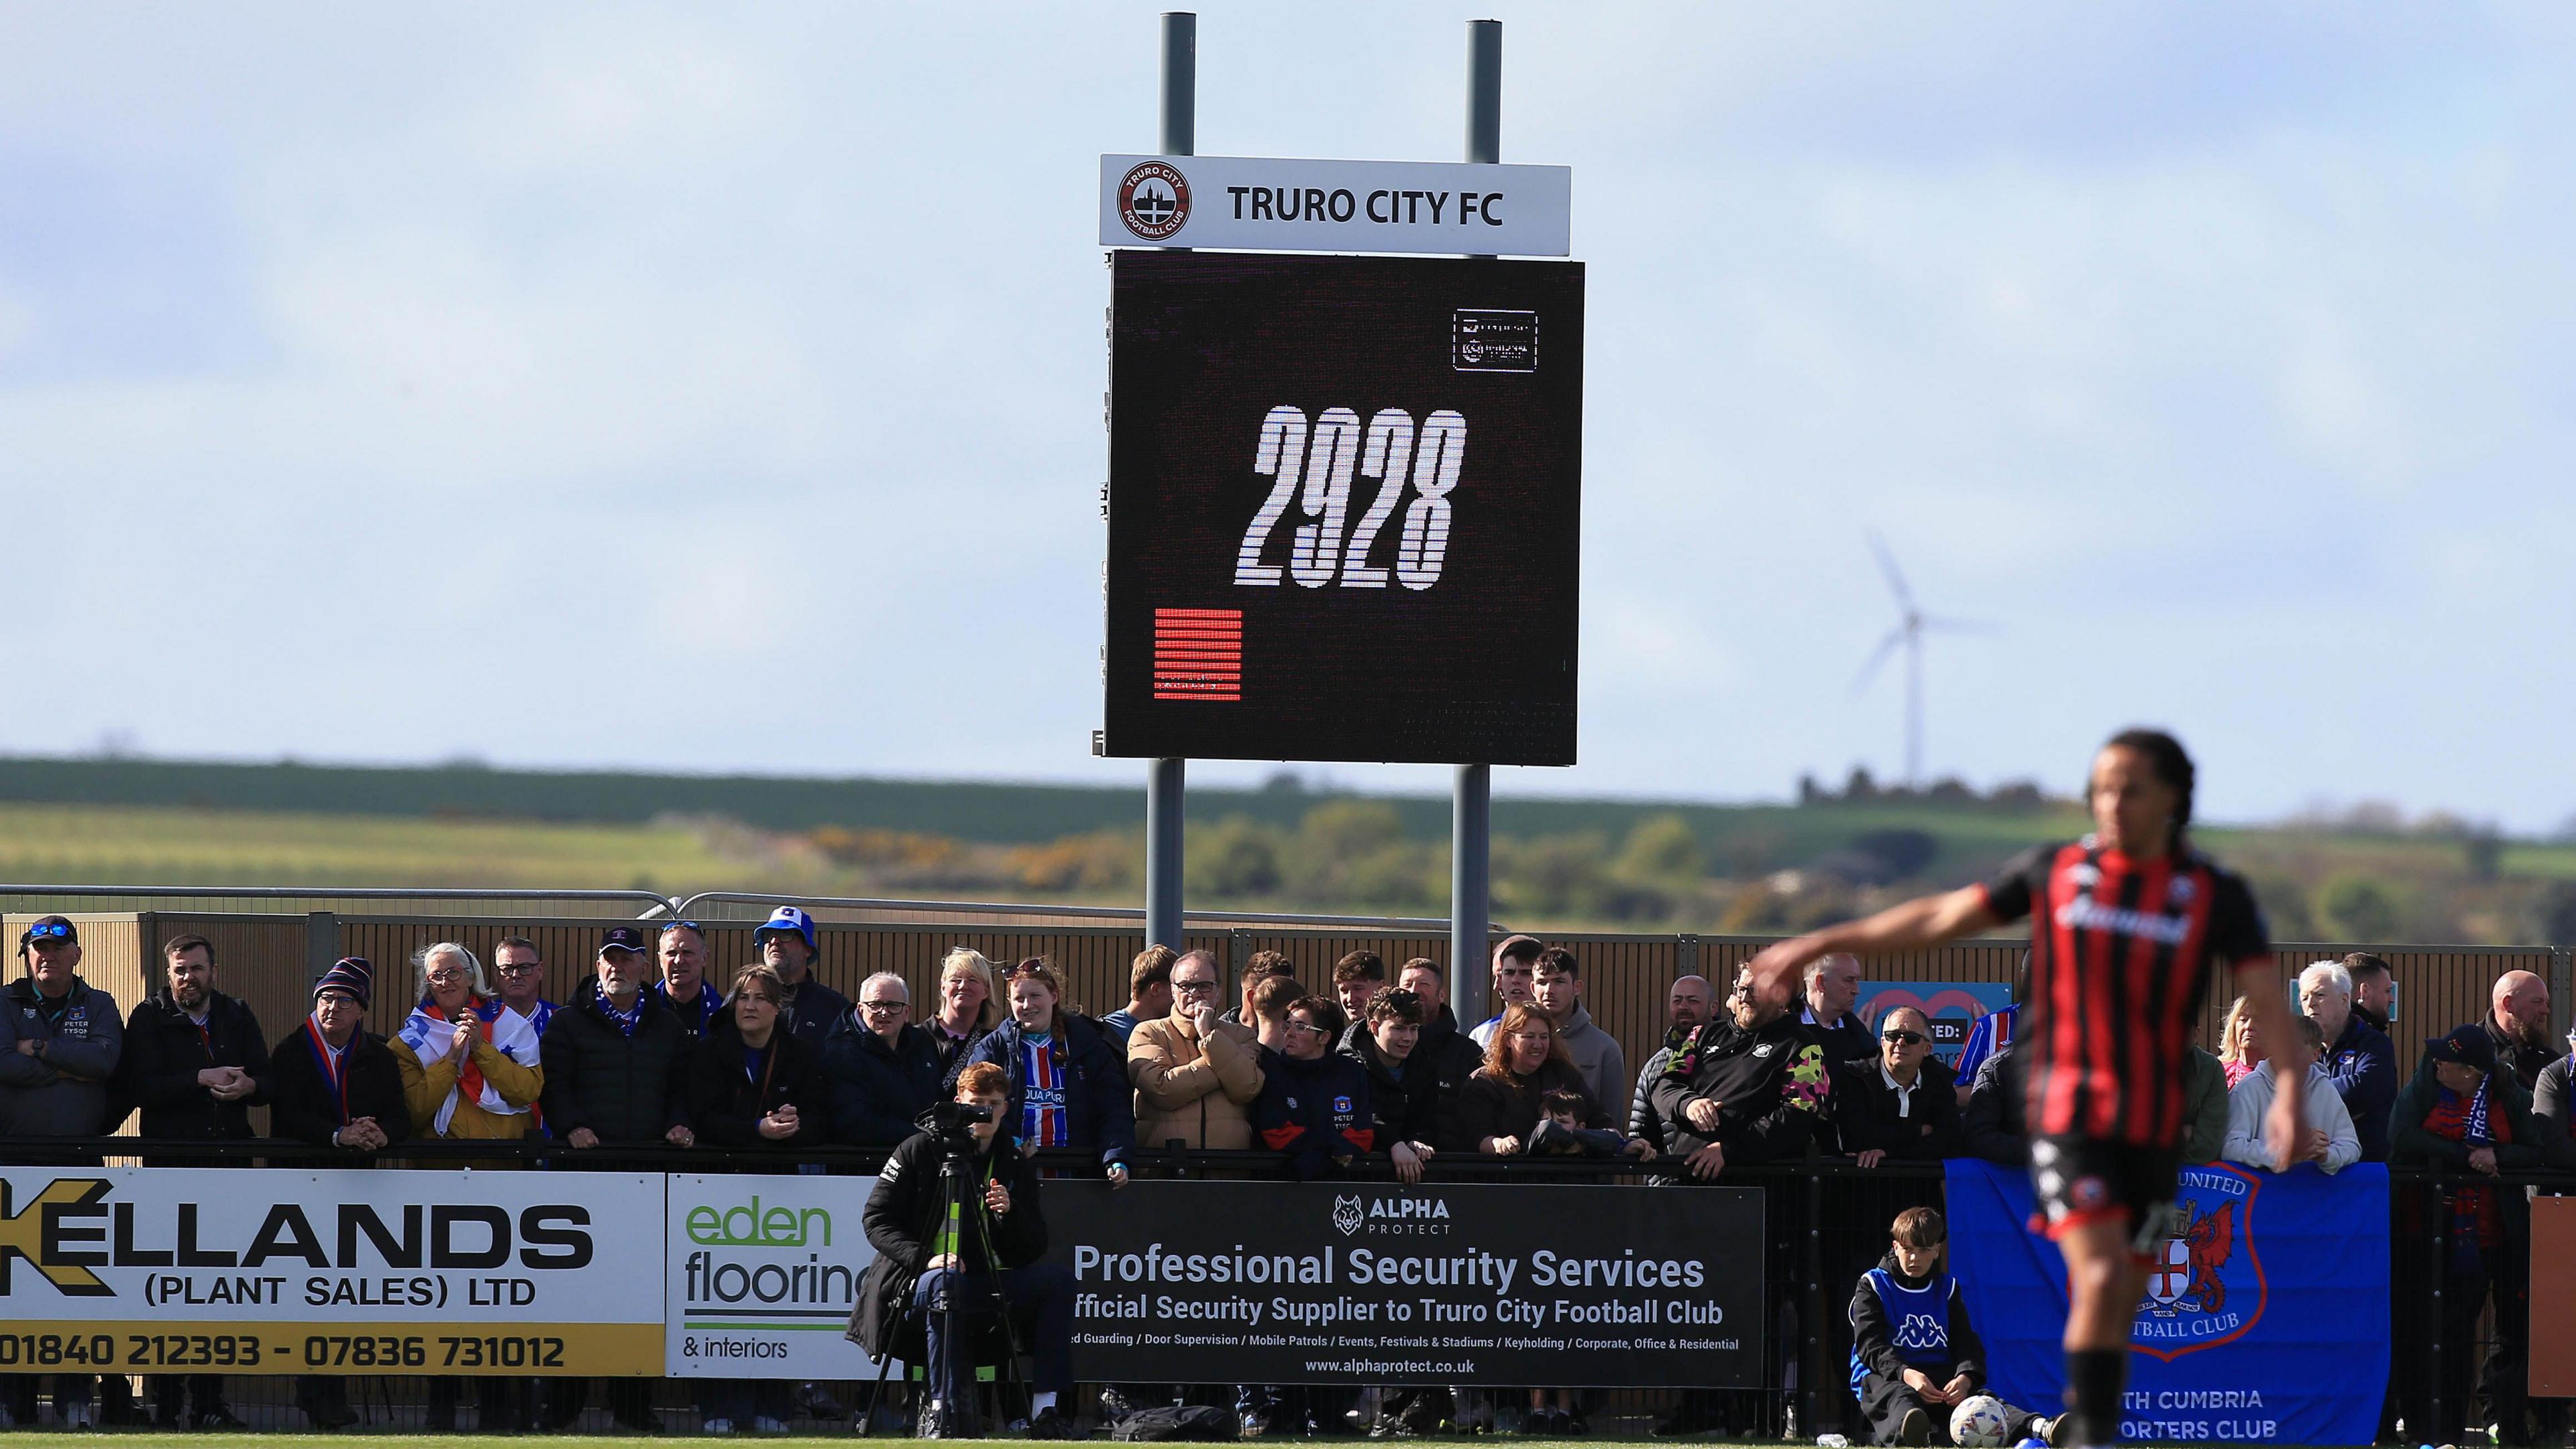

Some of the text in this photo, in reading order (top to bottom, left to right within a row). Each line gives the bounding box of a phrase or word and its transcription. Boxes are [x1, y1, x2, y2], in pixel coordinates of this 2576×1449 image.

[1126, 167, 1183, 188] TRURO CITY
[1227, 186, 1504, 226] TRURO CITY FC
[1124, 210, 1184, 235] FOOTBALL CLUB
[1232, 404, 1467, 591] 2928
[1931, 1025, 1960, 1038] ED:
[1025, 1089, 1044, 1100] QUA
[2178, 1172, 2246, 1195] UNITED
[1368, 1198, 1450, 1218] ALPHA
[686, 1195, 830, 1246] eden
[1368, 1224, 1450, 1234] PROTECT
[0, 1178, 594, 1297] KELLANDS
[1075, 1243, 1704, 1295] Professional Security Services
[145, 1273, 536, 1309] (PLANT SALES) LTD
[1075, 1293, 1723, 1329] fficial Security Supplier to Truro City Football Club
[2133, 1312, 2239, 1338] TBALL CLUB
[0, 1334, 114, 1365] 01840
[127, 1335, 260, 1366] 212393
[304, 1336, 425, 1366] 07836
[438, 1336, 564, 1367] 731012
[683, 1336, 788, 1358] & interiors
[1083, 1332, 1133, 1346] Guarding
[1145, 1334, 1171, 1344] Door
[1174, 1334, 1238, 1347] Supervision
[1250, 1334, 1286, 1346] Mobile
[1289, 1335, 1328, 1346] Patrols
[1338, 1336, 1377, 1348] Events,
[1380, 1336, 1429, 1347] Festivals
[1432, 1337, 1440, 1347] &
[1442, 1336, 1494, 1347] Stadiums
[1505, 1337, 1564, 1350] Keyholding
[1575, 1338, 1631, 1351] Corporate,
[1634, 1338, 1666, 1349] Office
[1668, 1339, 1676, 1349] &
[1680, 1338, 1739, 1350] Residential
[1305, 1358, 1474, 1375] www.alphaprotect.co.uk
[2158, 1391, 2263, 1409] CUMBRIA
[2121, 1420, 2277, 1439] ORTERS CLUB
